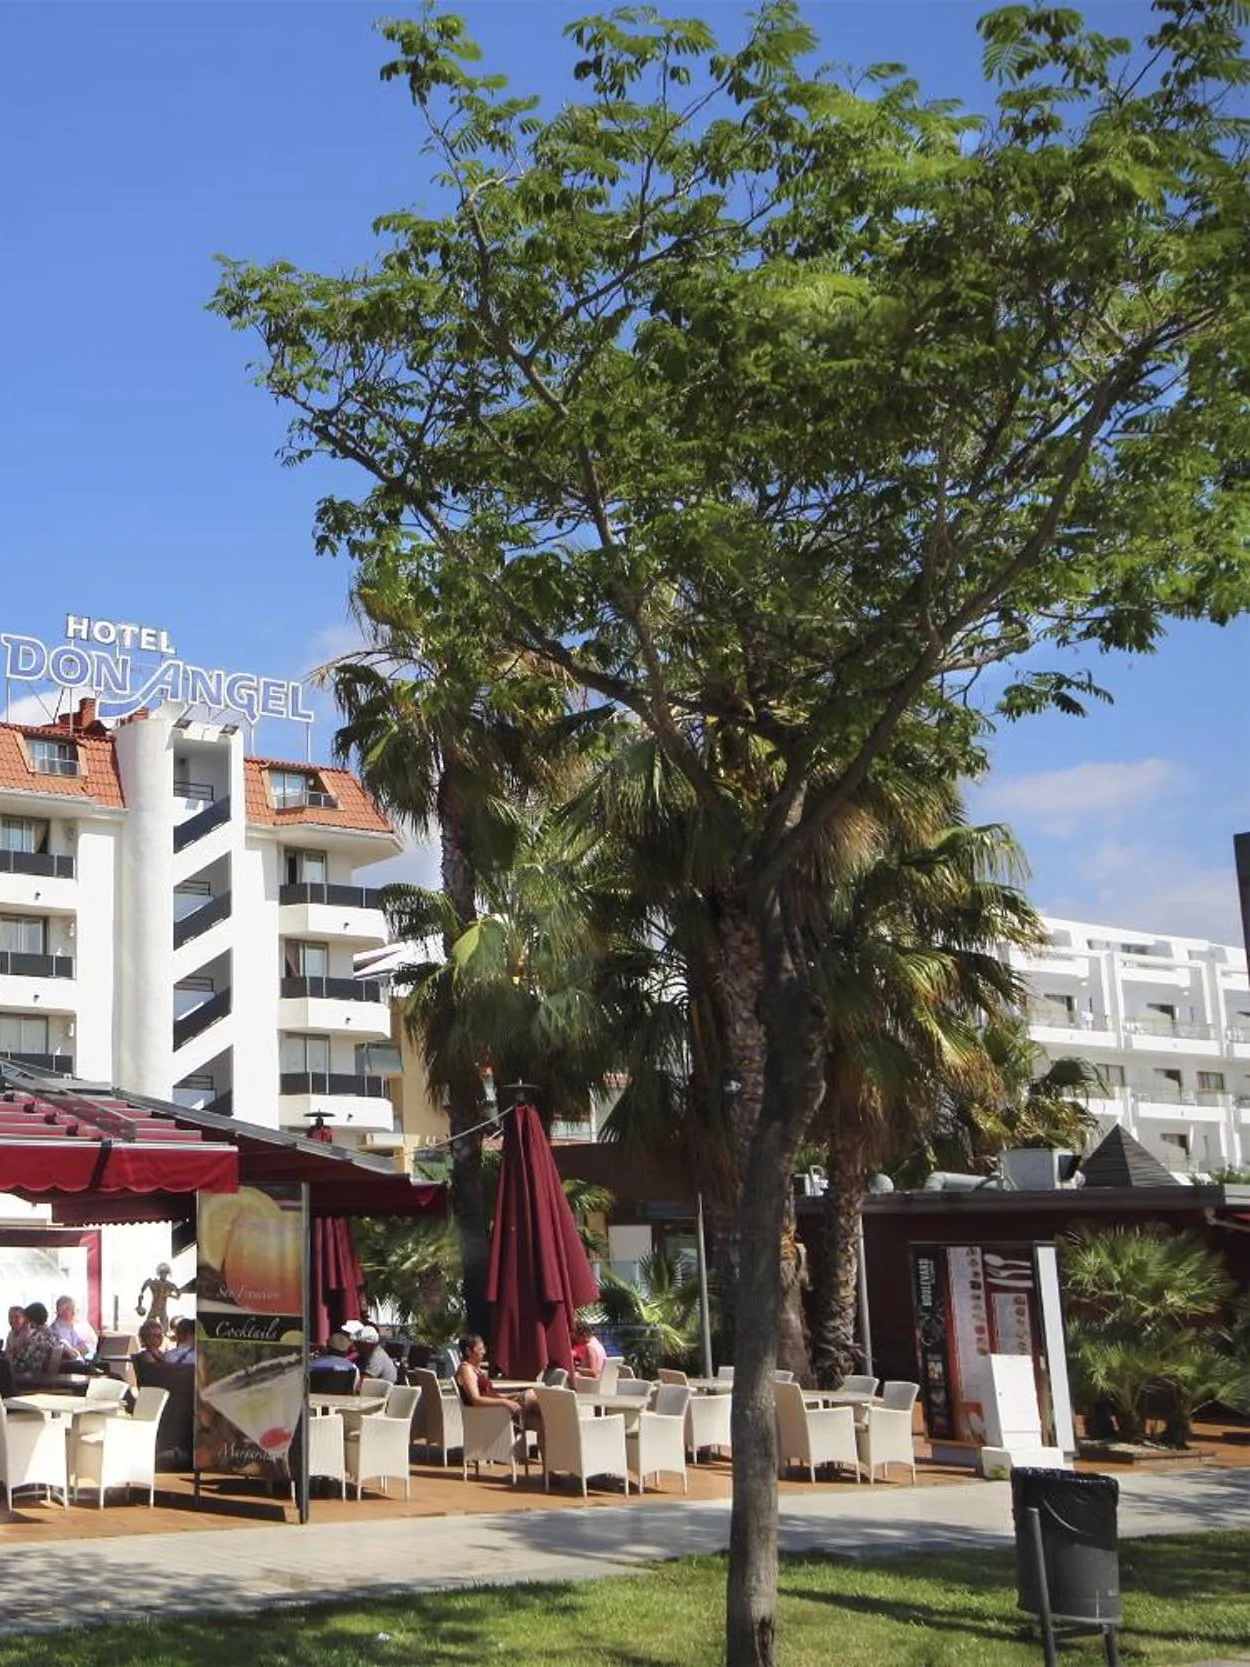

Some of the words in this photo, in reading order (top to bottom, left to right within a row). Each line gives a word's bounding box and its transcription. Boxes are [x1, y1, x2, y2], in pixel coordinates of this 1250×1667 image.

[66, 614, 176, 655] HOTEL
[1, 633, 131, 694] DON
[94, 659, 315, 724] ANGEL
[918, 1258, 933, 1306] BOULEVARD
[216, 1316, 280, 1340] Cocktails
